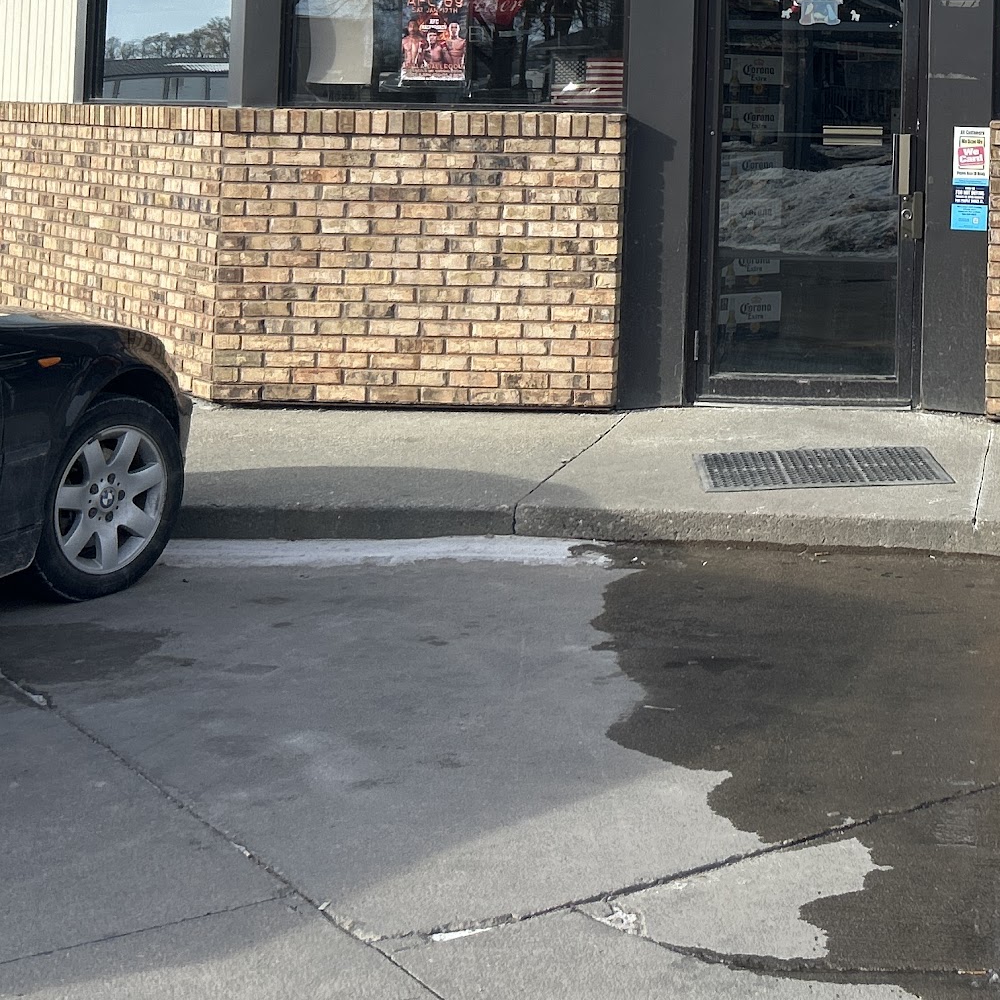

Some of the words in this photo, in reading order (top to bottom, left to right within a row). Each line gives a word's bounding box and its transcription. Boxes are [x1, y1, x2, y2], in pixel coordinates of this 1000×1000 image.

[742, 64, 775, 75] Corona
[743, 112, 775, 123] Corona
[963, 148, 979, 156] We
[960, 155, 983, 163] Card
[742, 160, 774, 171] Corona
[740, 303, 772, 315] Corona
